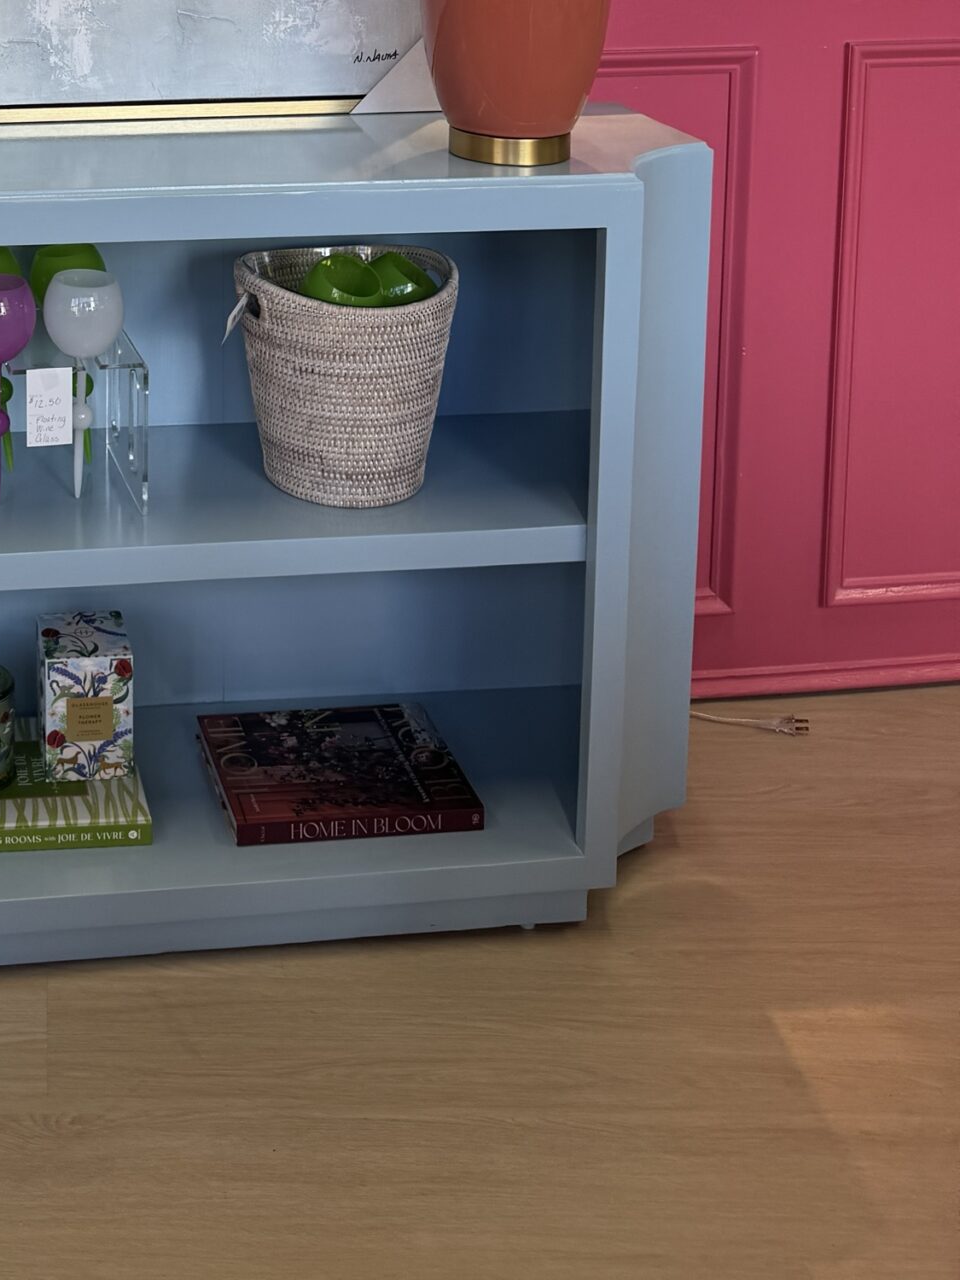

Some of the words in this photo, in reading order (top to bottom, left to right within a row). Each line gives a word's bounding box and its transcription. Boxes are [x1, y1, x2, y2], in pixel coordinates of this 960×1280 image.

[35, 414, 67, 429] Floating
[36, 424, 55, 433] Wine
[35, 433, 60, 444] Glass
[290, 819, 346, 840] HOME
[352, 818, 368, 836] IN
[373, 814, 443, 835] BLOOM
[5, 833, 42, 845] ROOMS
[58, 832, 79, 844] JOIE
[81, 831, 94, 842] DE
[97, 830, 125, 841] VIVRE
